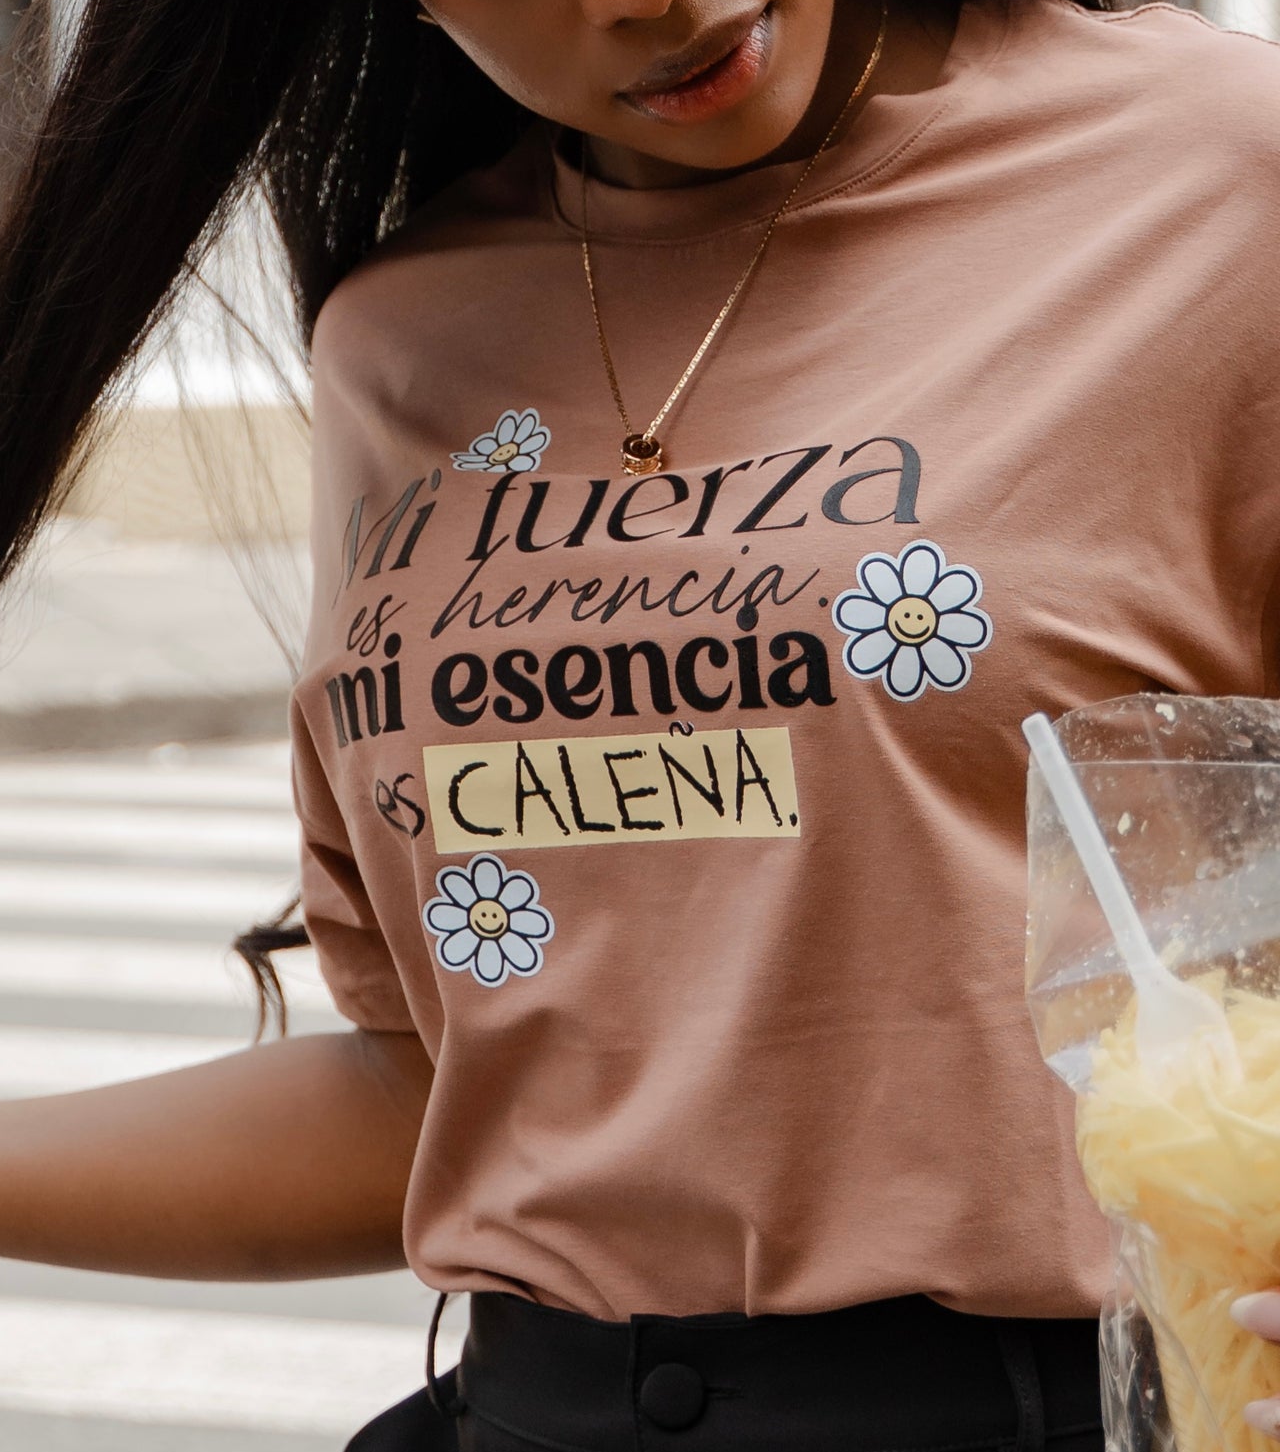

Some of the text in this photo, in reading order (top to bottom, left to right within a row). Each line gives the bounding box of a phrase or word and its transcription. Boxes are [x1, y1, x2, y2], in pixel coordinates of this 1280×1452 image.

[331, 435, 922, 610] Mi fuerza
[346, 534, 829, 657] es herencia.
[325, 603, 838, 749] mi esencia
[375, 720, 799, 840] es CALEÑA.
